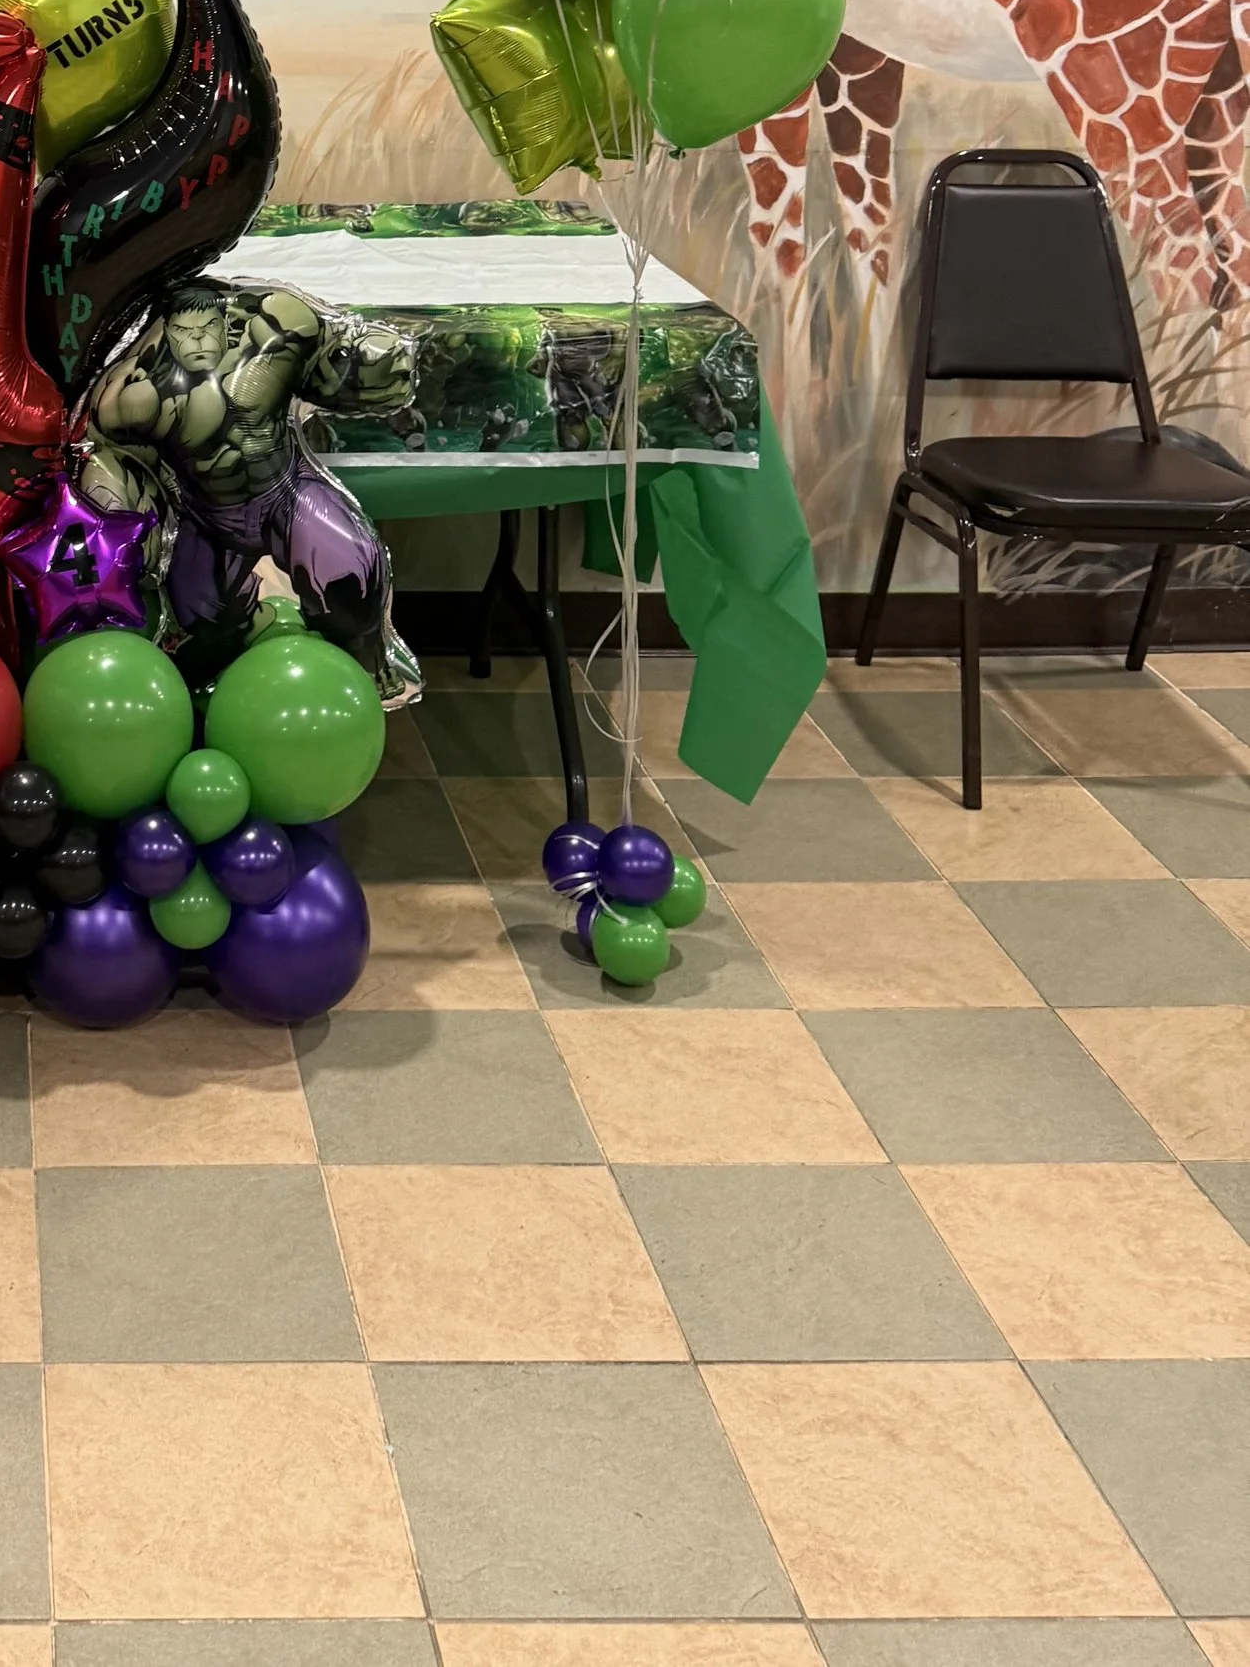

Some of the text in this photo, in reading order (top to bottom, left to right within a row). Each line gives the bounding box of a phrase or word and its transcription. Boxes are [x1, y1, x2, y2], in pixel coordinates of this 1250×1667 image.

[179, 40, 250, 211] HAPPY
[41, 180, 165, 383] BIRTHDAY
[49, 522, 100, 587] 4
